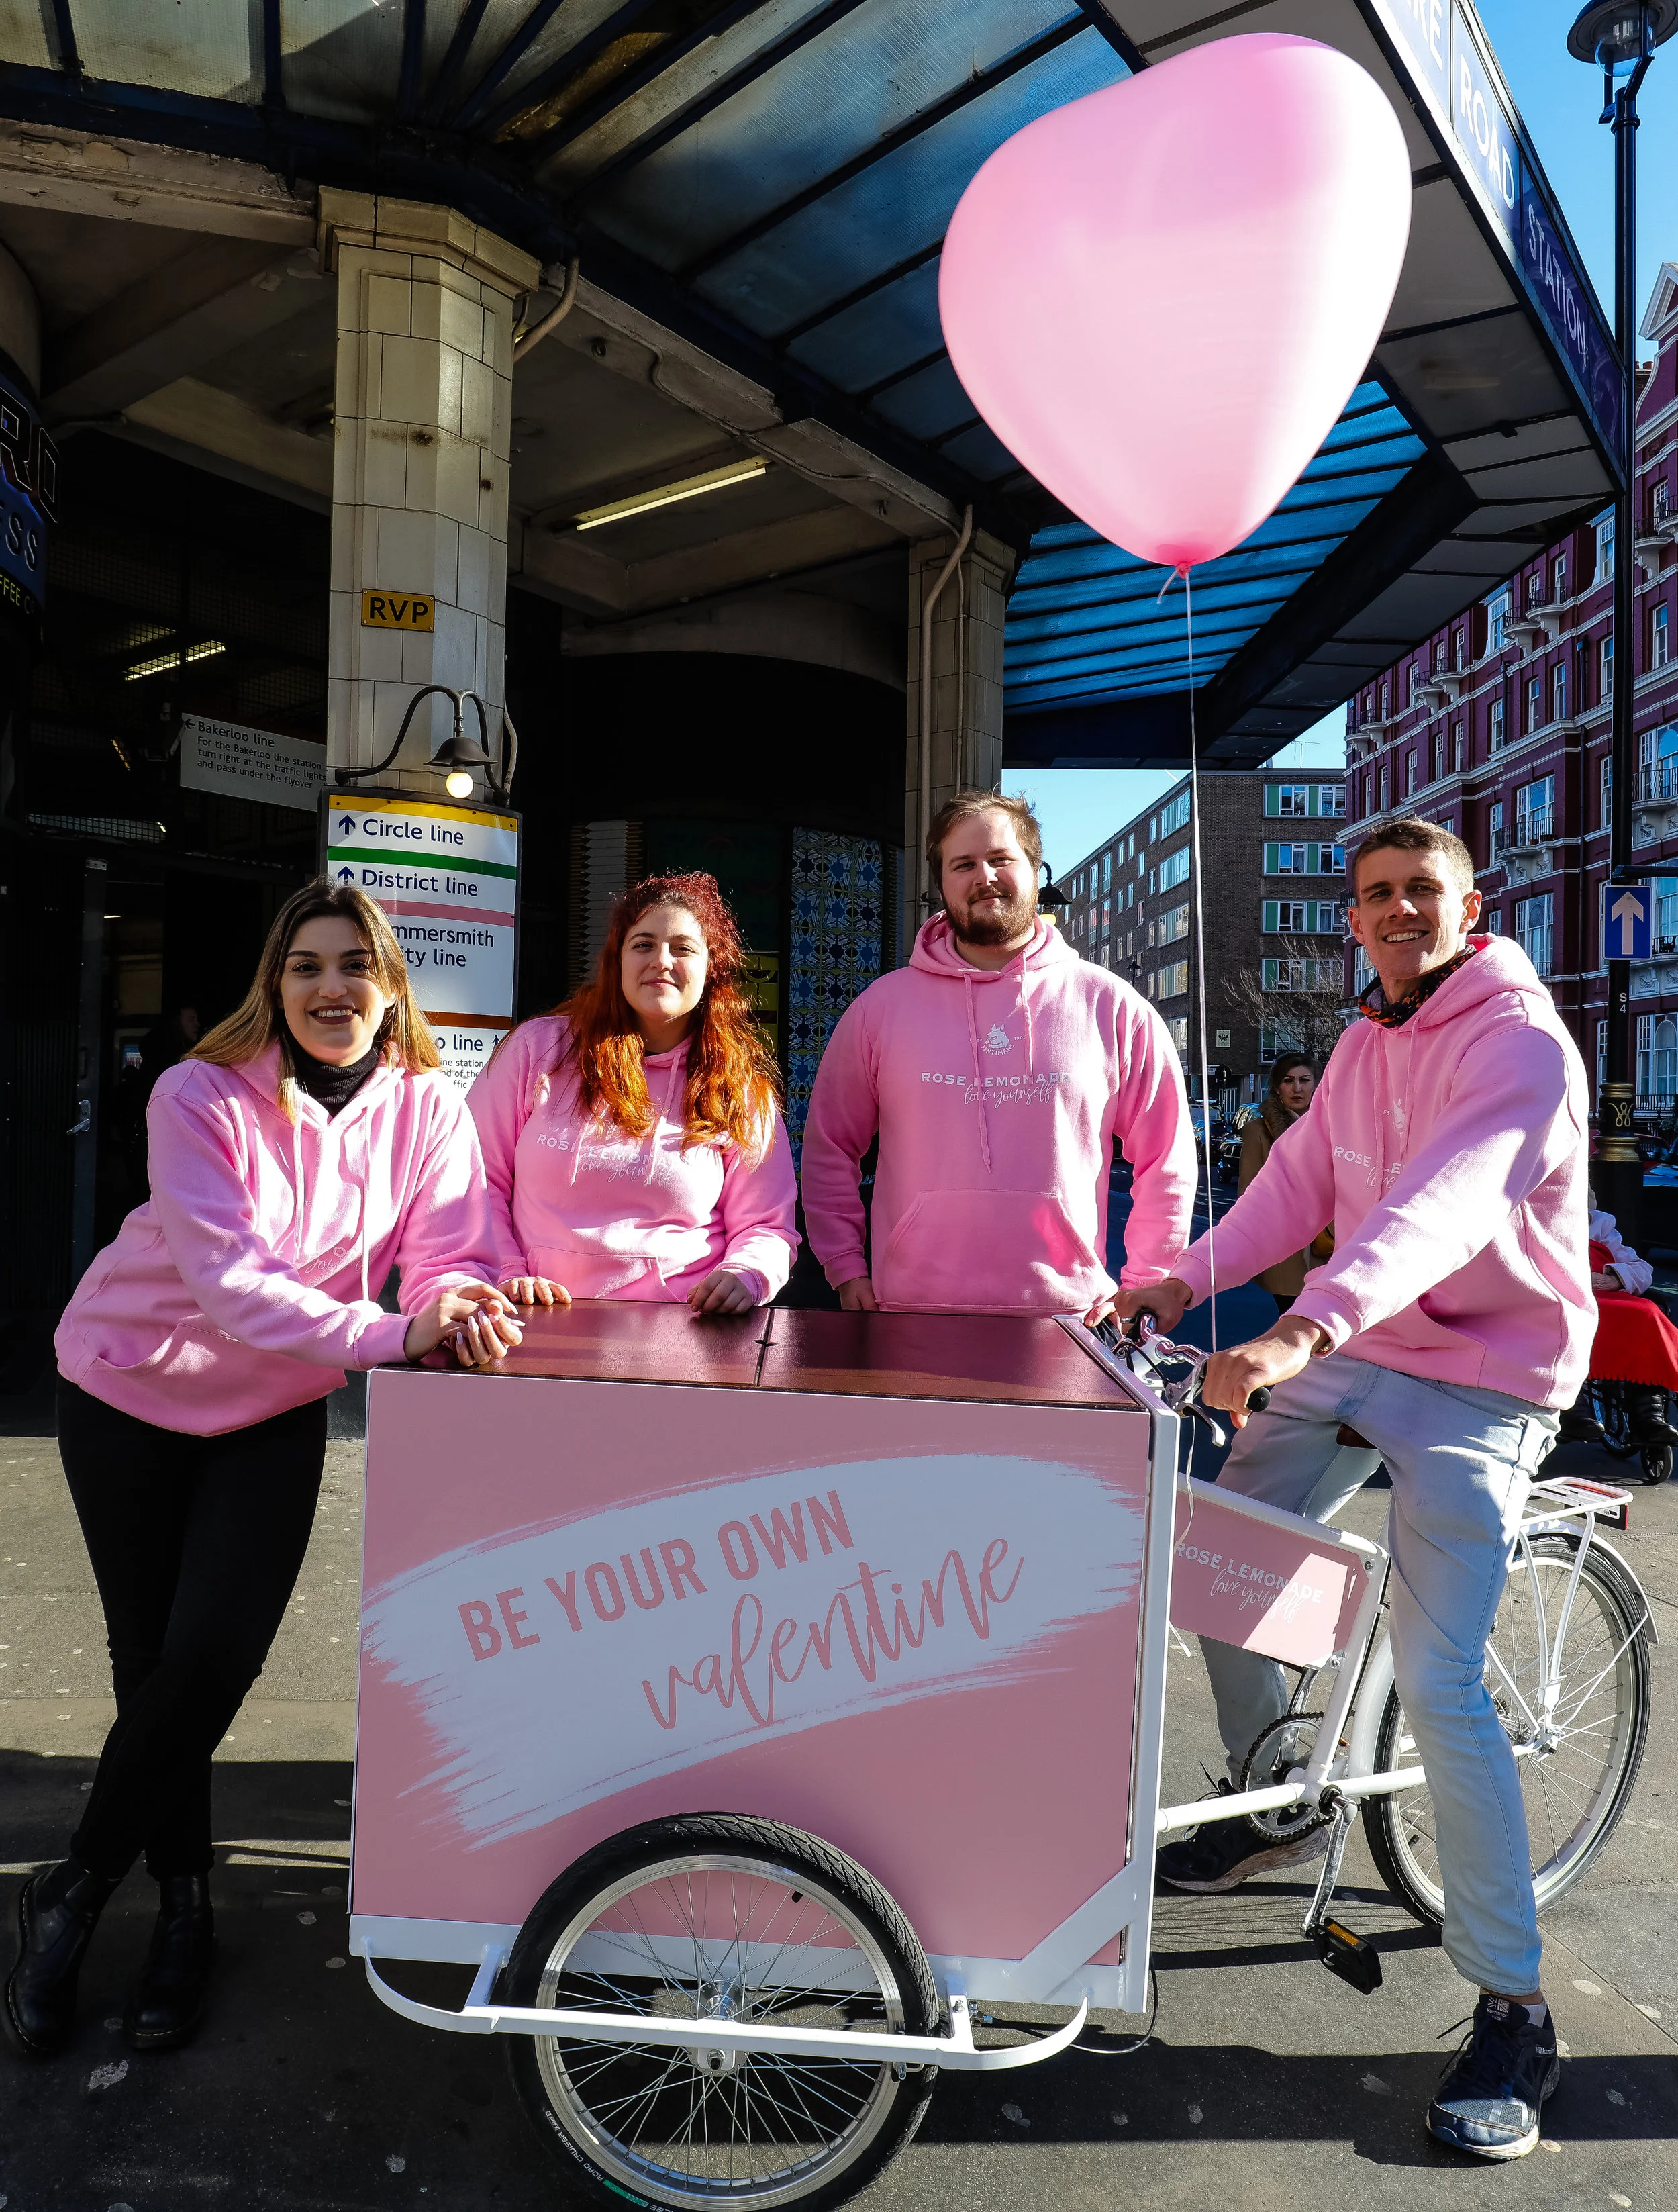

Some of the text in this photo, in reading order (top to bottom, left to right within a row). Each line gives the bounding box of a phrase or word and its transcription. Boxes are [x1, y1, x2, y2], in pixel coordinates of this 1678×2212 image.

[1460, 53, 1514, 210] ROAD
[1528, 203, 1587, 366] STATION
[369, 596, 428, 624] RVP
[197, 720, 275, 748] Bakerloo line
[197, 736, 322, 770] For the Bakerloo line station
[197, 748, 326, 782] turn right at the traffic lights
[197, 759, 312, 789] and pass under the flyover
[362, 818, 464, 845] Circle line
[362, 869, 478, 896] District line
[434, 948, 466, 967] line
[1619, 992, 1627, 1002] S
[1619, 1004, 1627, 1014] 4
[453, 1033, 483, 1051] line
[981, 1044, 1015, 1055] FENTIMANS
[454, 1069, 464, 1077] of
[456, 1059, 483, 1067] station
[921, 1072, 967, 1086] ROSE
[993, 1079, 1057, 1109] yourself
[1333, 1145, 1371, 1168] ROSE
[457, 1490, 854, 1662] BE YOUR OWN
[1173, 1541, 1324, 1604] ROSE LEMONADE
[1210, 1568, 1306, 1624] love yourself
[642, 1537, 1025, 1730] valentine
[558, 2131, 583, 2162] CRUISER
[583, 2162, 604, 2181] ROAD
